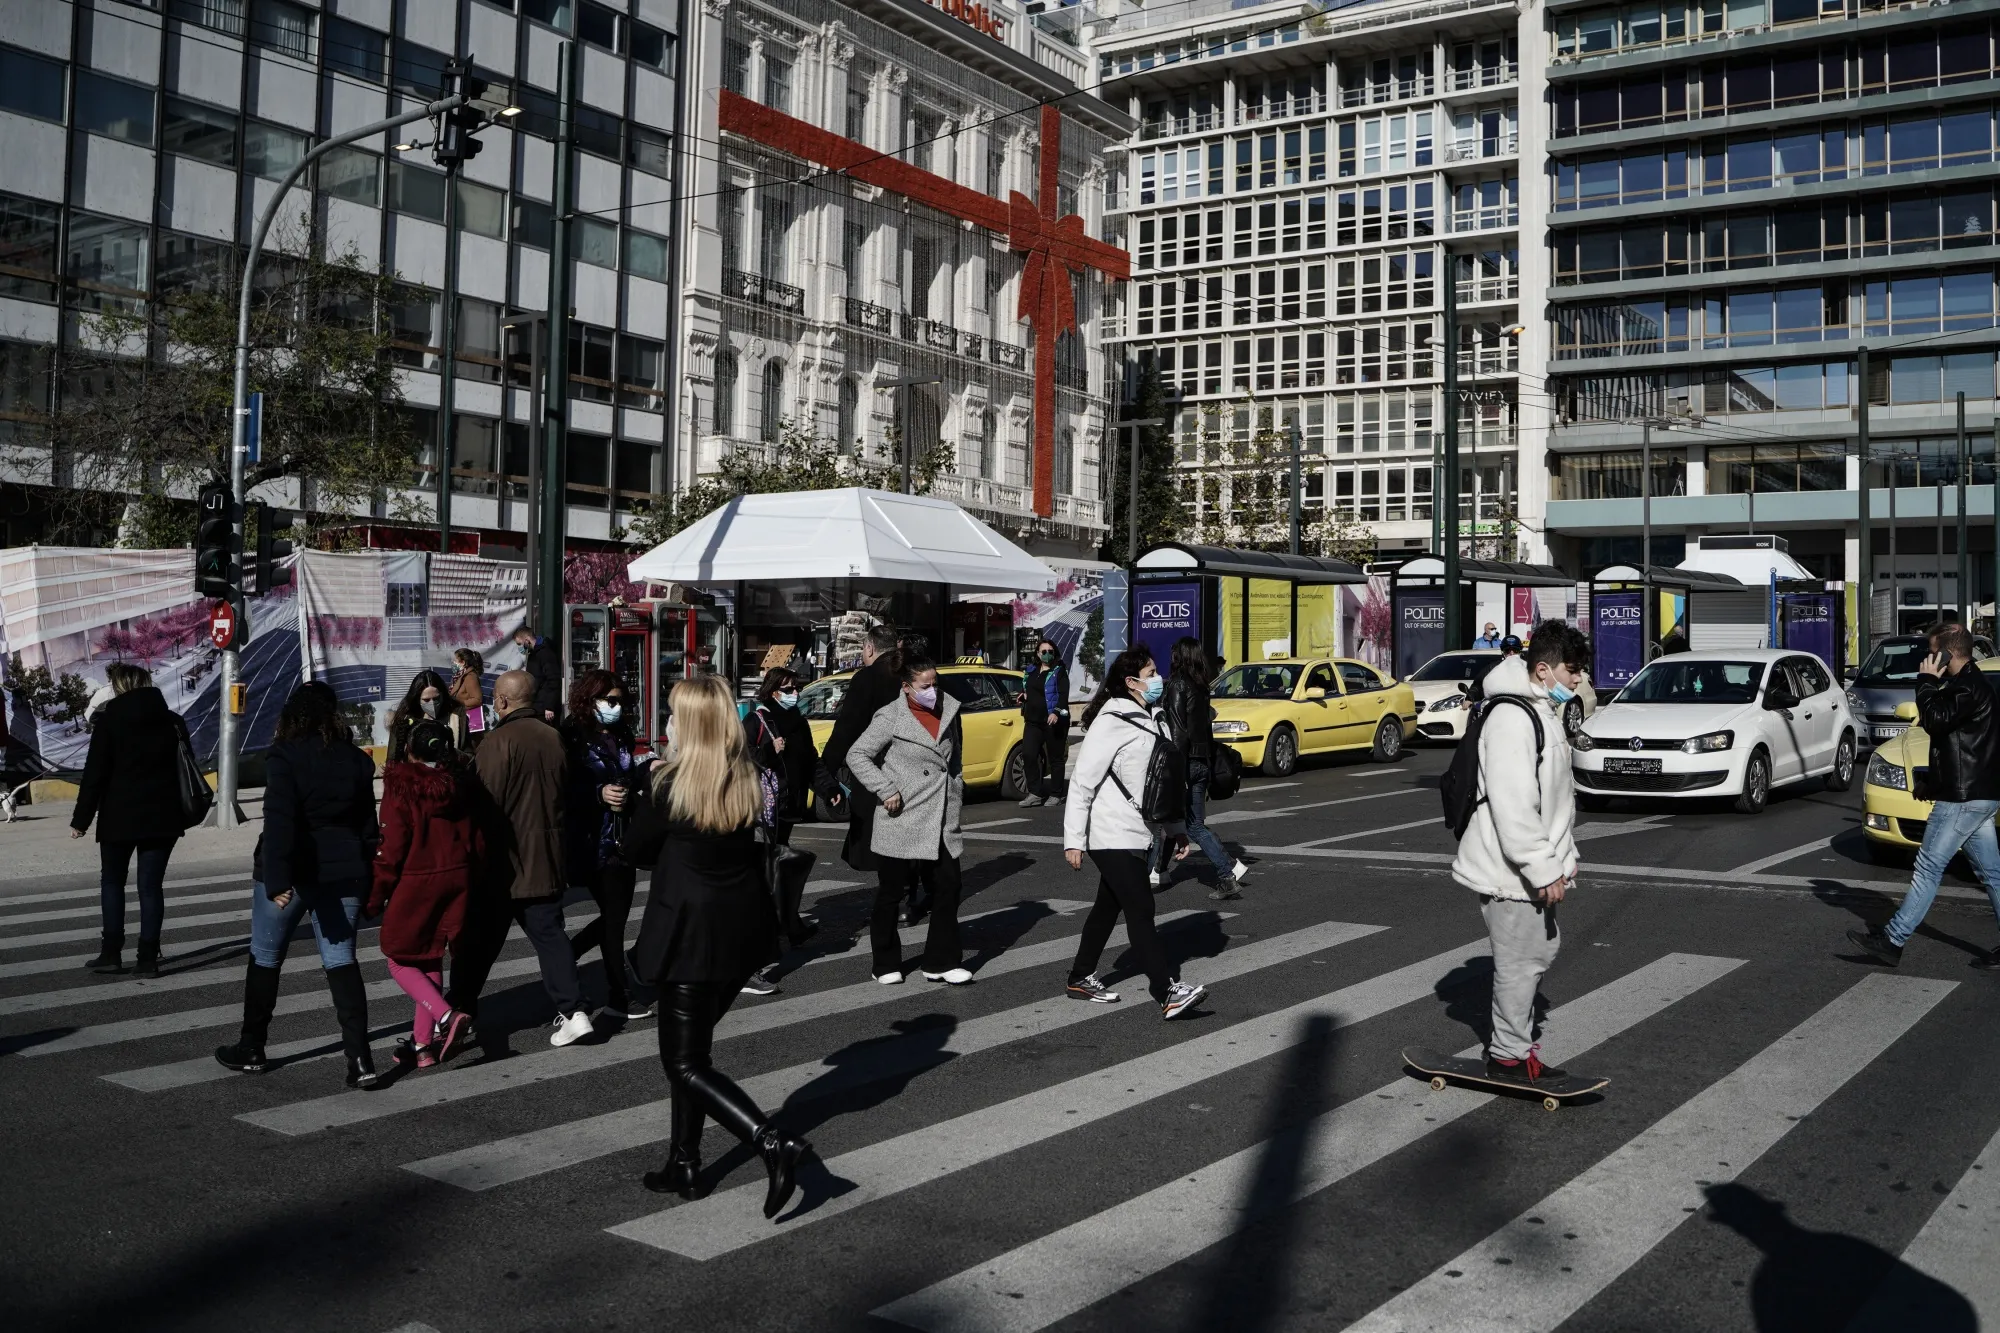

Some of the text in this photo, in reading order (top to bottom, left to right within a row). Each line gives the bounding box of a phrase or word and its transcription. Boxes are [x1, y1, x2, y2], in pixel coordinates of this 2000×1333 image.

[926, 0, 1005, 41] ublic
[1142, 603, 1190, 618] POLITIS
[1601, 607, 1641, 618] POLITIS
[1792, 606, 1828, 616] POLITIS
